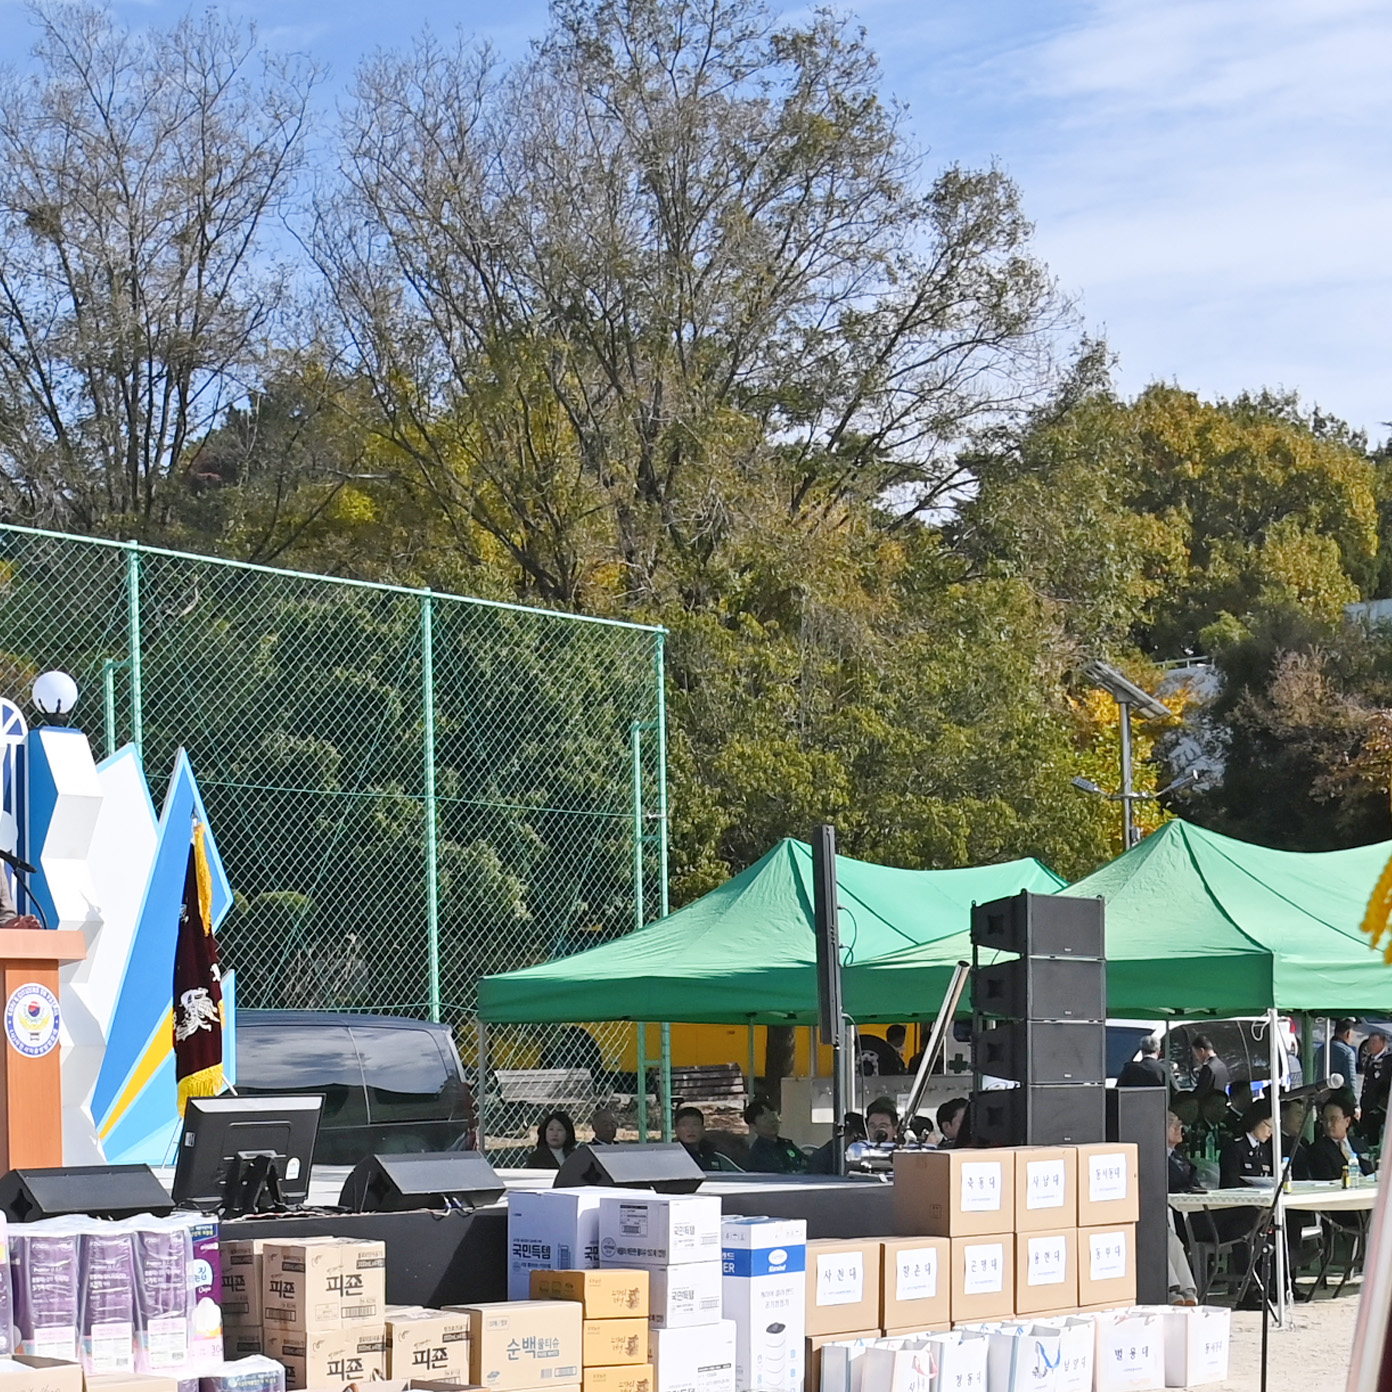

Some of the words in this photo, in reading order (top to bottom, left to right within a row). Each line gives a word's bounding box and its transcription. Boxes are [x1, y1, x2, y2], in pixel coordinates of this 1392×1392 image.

[270, 1279, 296, 1299] 피죤
[326, 1273, 364, 1298] 피죤
[411, 1346, 449, 1371] 피죤
[506, 1336, 537, 1361] 순백
[327, 1358, 365, 1382] 피죤
